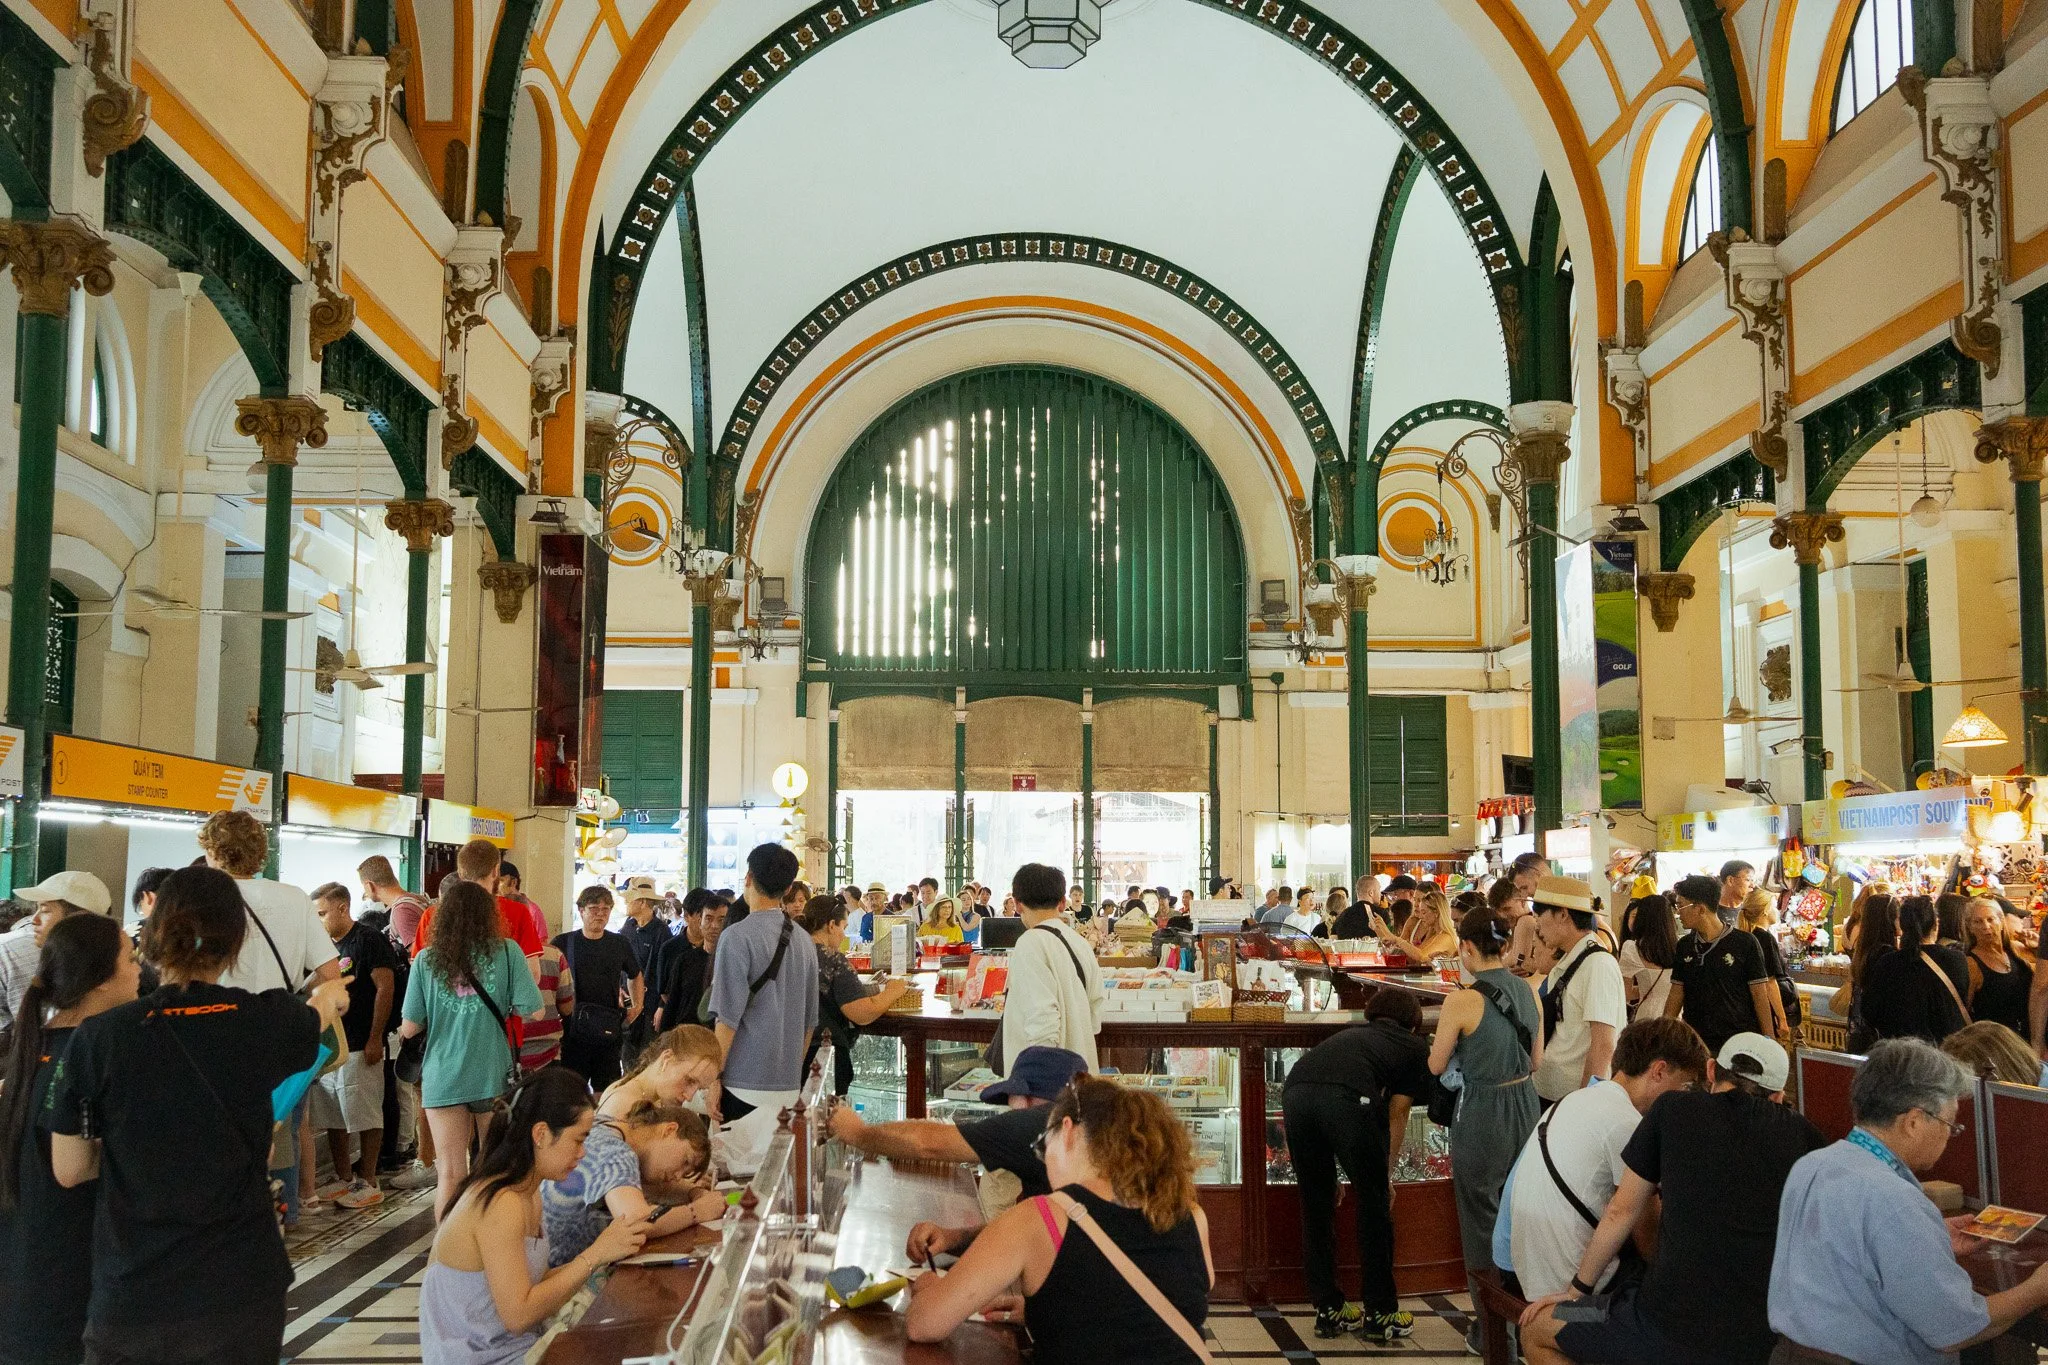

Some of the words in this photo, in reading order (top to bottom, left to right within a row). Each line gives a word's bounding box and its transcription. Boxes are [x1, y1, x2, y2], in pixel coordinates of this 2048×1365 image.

[543, 565, 583, 576] Vietnam
[151, 762, 164, 779] TEM
[1, 778, 21, 787] POST
[128, 784, 145, 796] STAMP
[146, 786, 169, 799] COUNTER
[1838, 803, 1920, 830] VIETNAMPOST
[1926, 798, 1993, 824] SOUV
